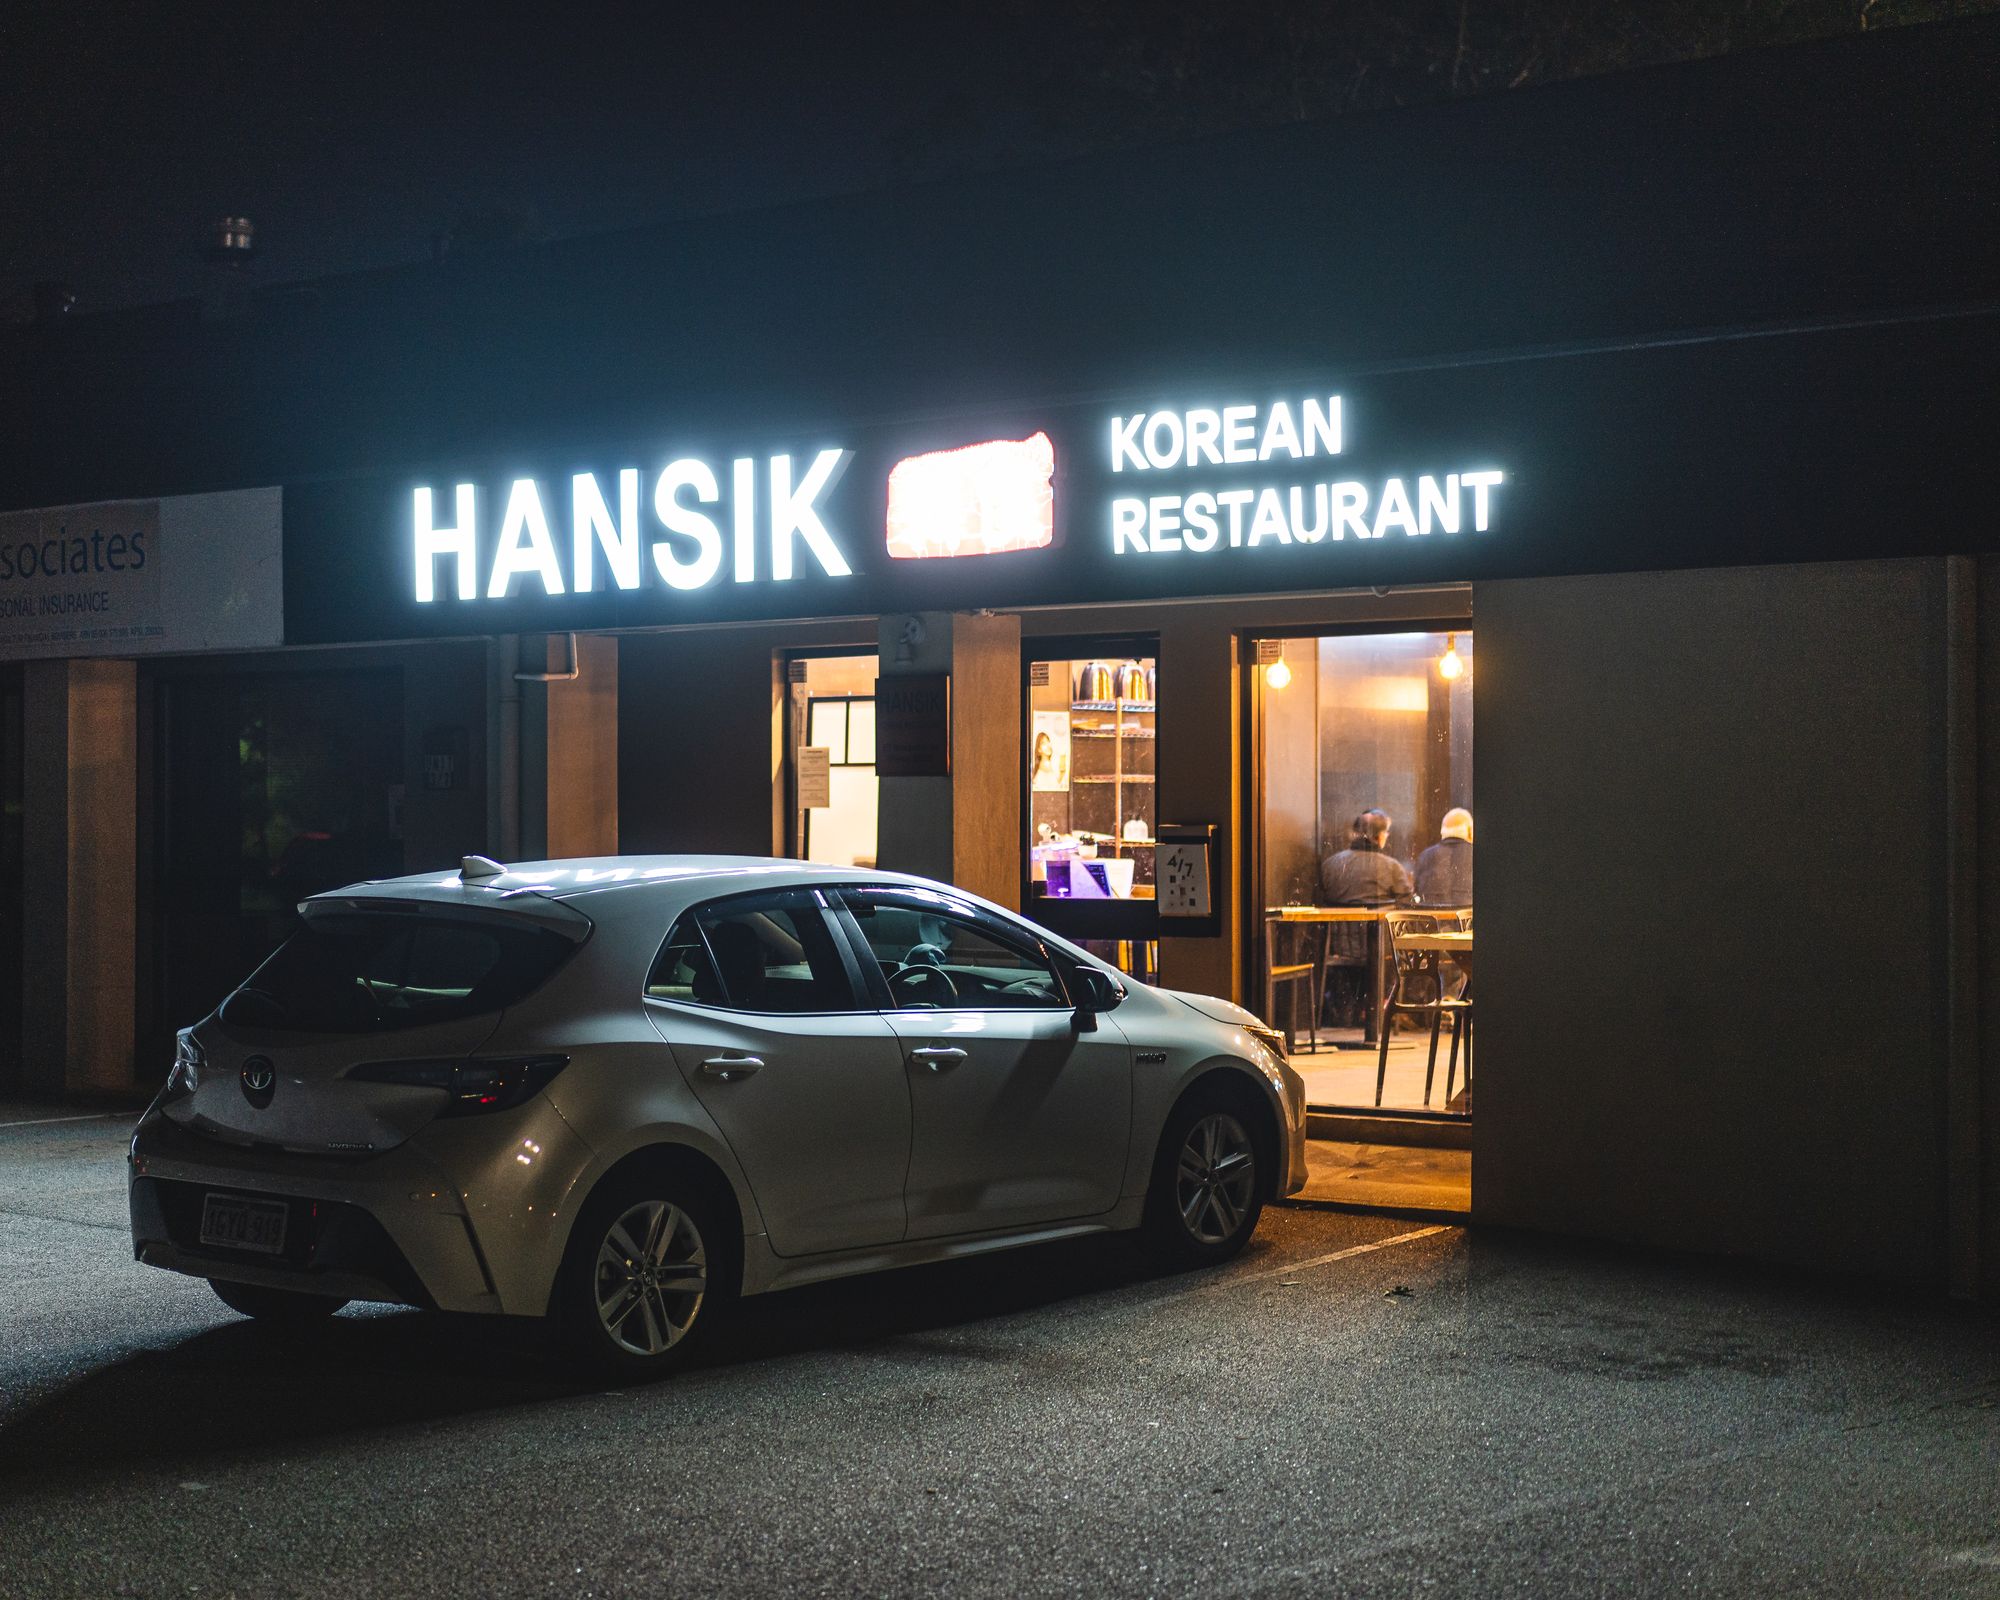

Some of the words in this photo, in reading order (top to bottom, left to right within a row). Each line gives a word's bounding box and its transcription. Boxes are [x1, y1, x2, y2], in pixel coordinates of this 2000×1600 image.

[1110, 396, 1342, 473] KOREAN
[413, 448, 853, 602] HANSIK
[1112, 471, 1503, 555] RESTAURANT
[0, 526, 146, 580] sociates
[39, 592, 109, 616] INSURANCE
